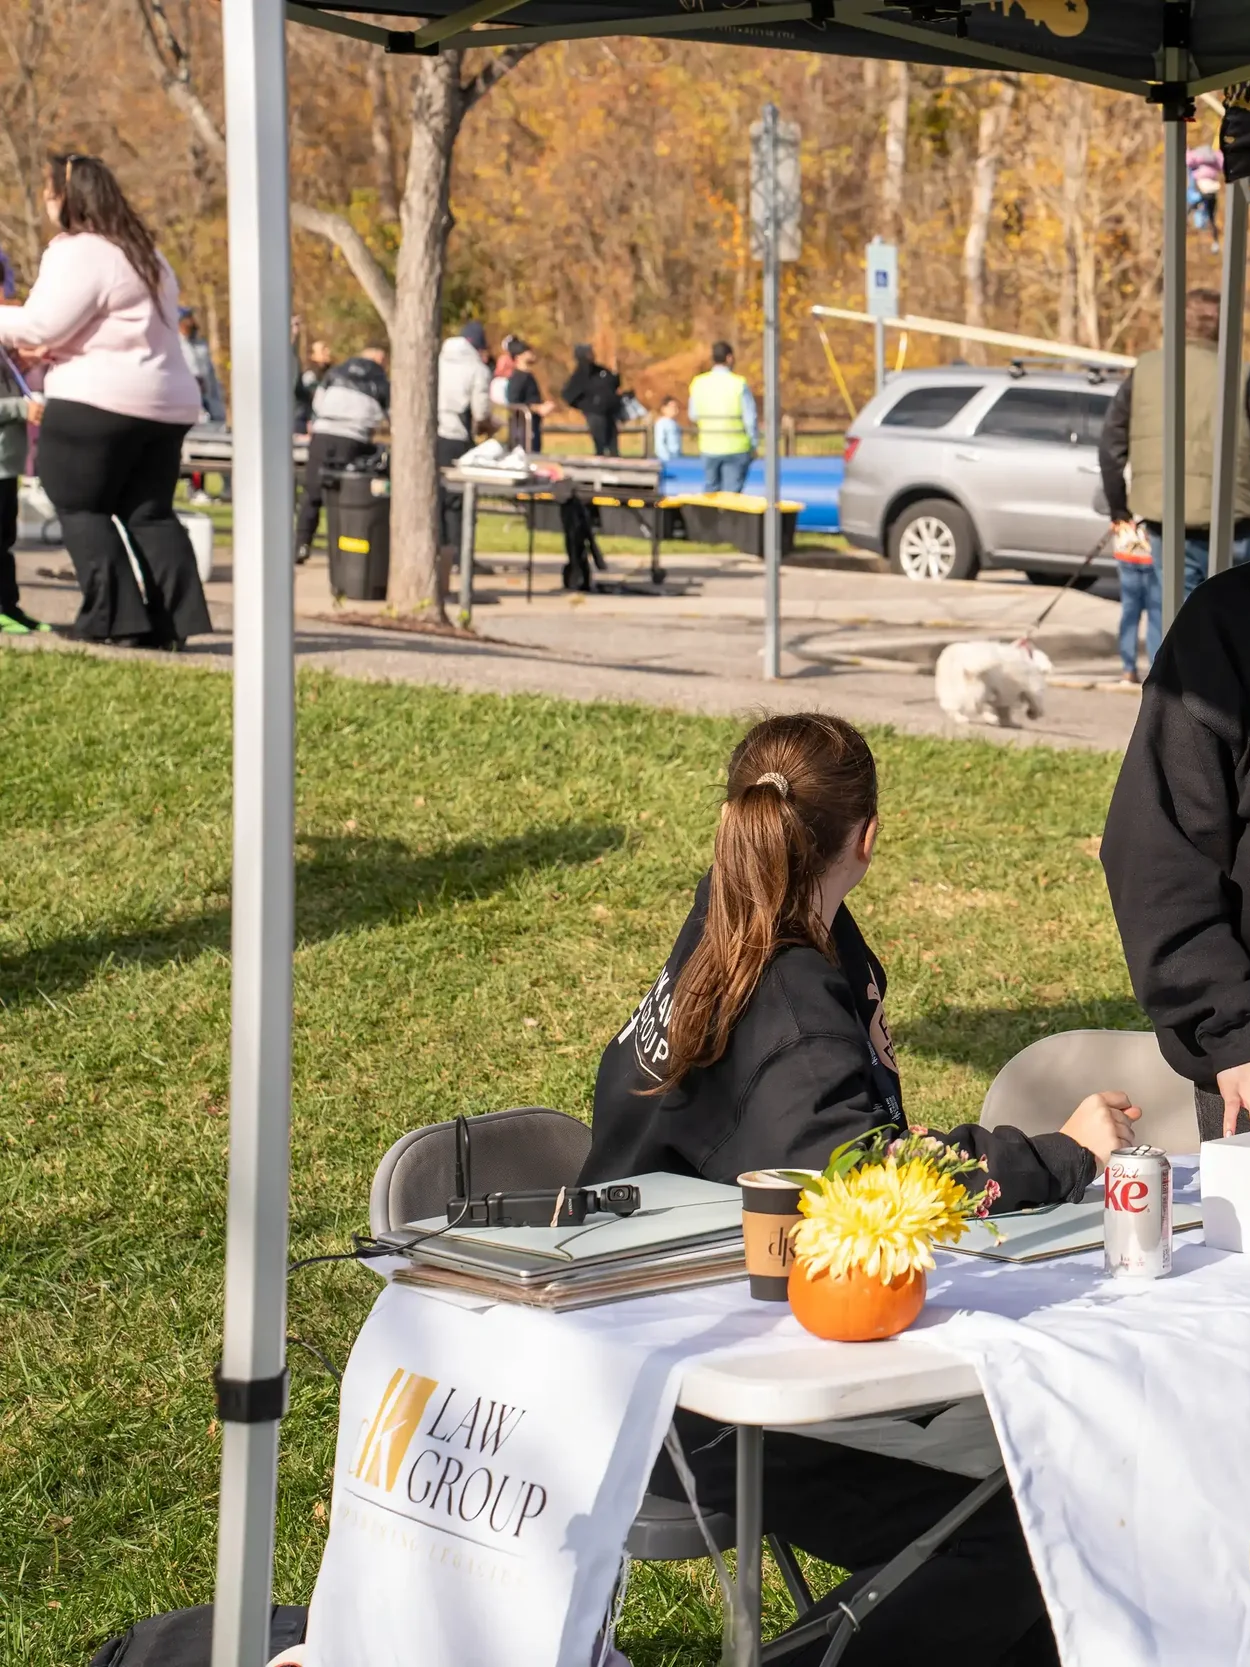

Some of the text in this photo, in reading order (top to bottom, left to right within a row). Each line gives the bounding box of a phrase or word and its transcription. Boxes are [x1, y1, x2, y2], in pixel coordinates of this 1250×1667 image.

[1104, 1166, 1149, 1213] ke
[426, 1387, 527, 1457] LAW
[407, 1449, 547, 1537] GROUP
